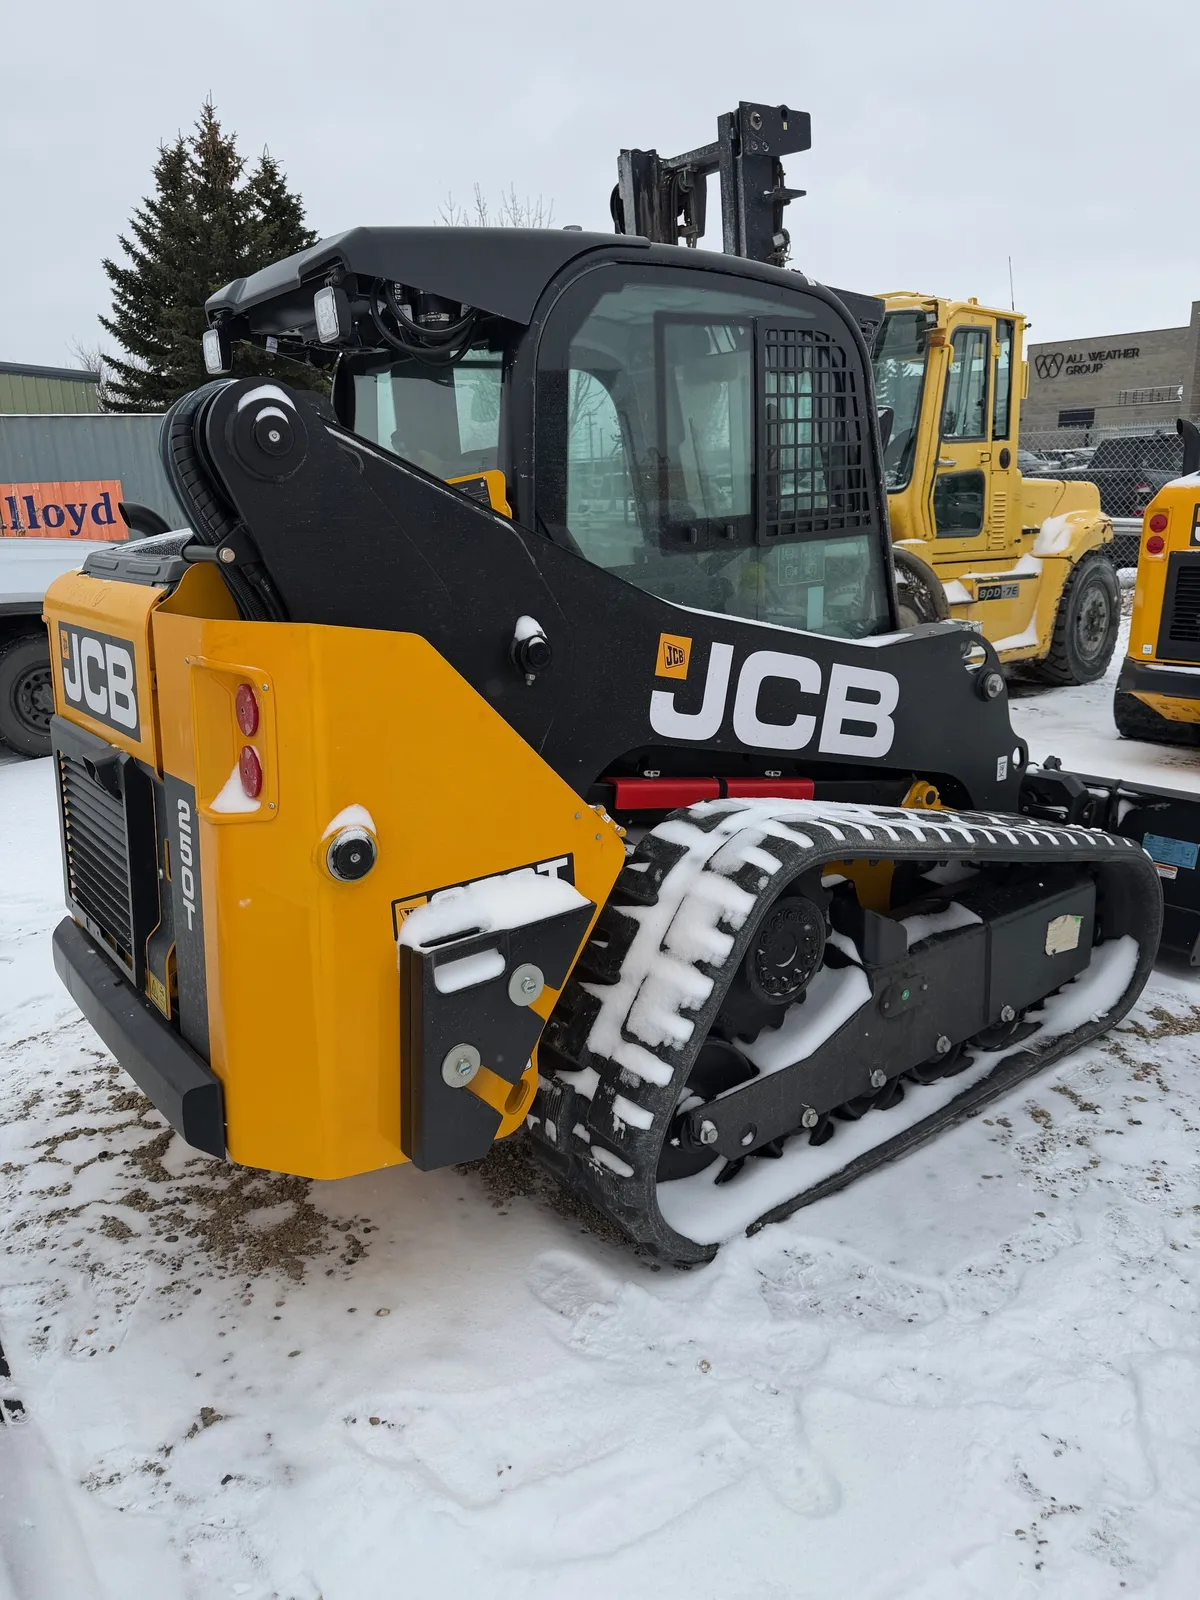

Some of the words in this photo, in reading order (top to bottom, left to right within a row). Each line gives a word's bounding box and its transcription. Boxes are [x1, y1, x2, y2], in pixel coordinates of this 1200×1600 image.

[1066, 354, 1087, 364] ALL
[1088, 348, 1140, 362] WEATHER
[1066, 363, 1103, 375] GROUP
[0, 492, 116, 536] lloyd
[666, 645, 684, 666] JCB
[63, 632, 138, 730] JCB
[649, 641, 900, 759] JCB
[177, 798, 196, 932] 250T
